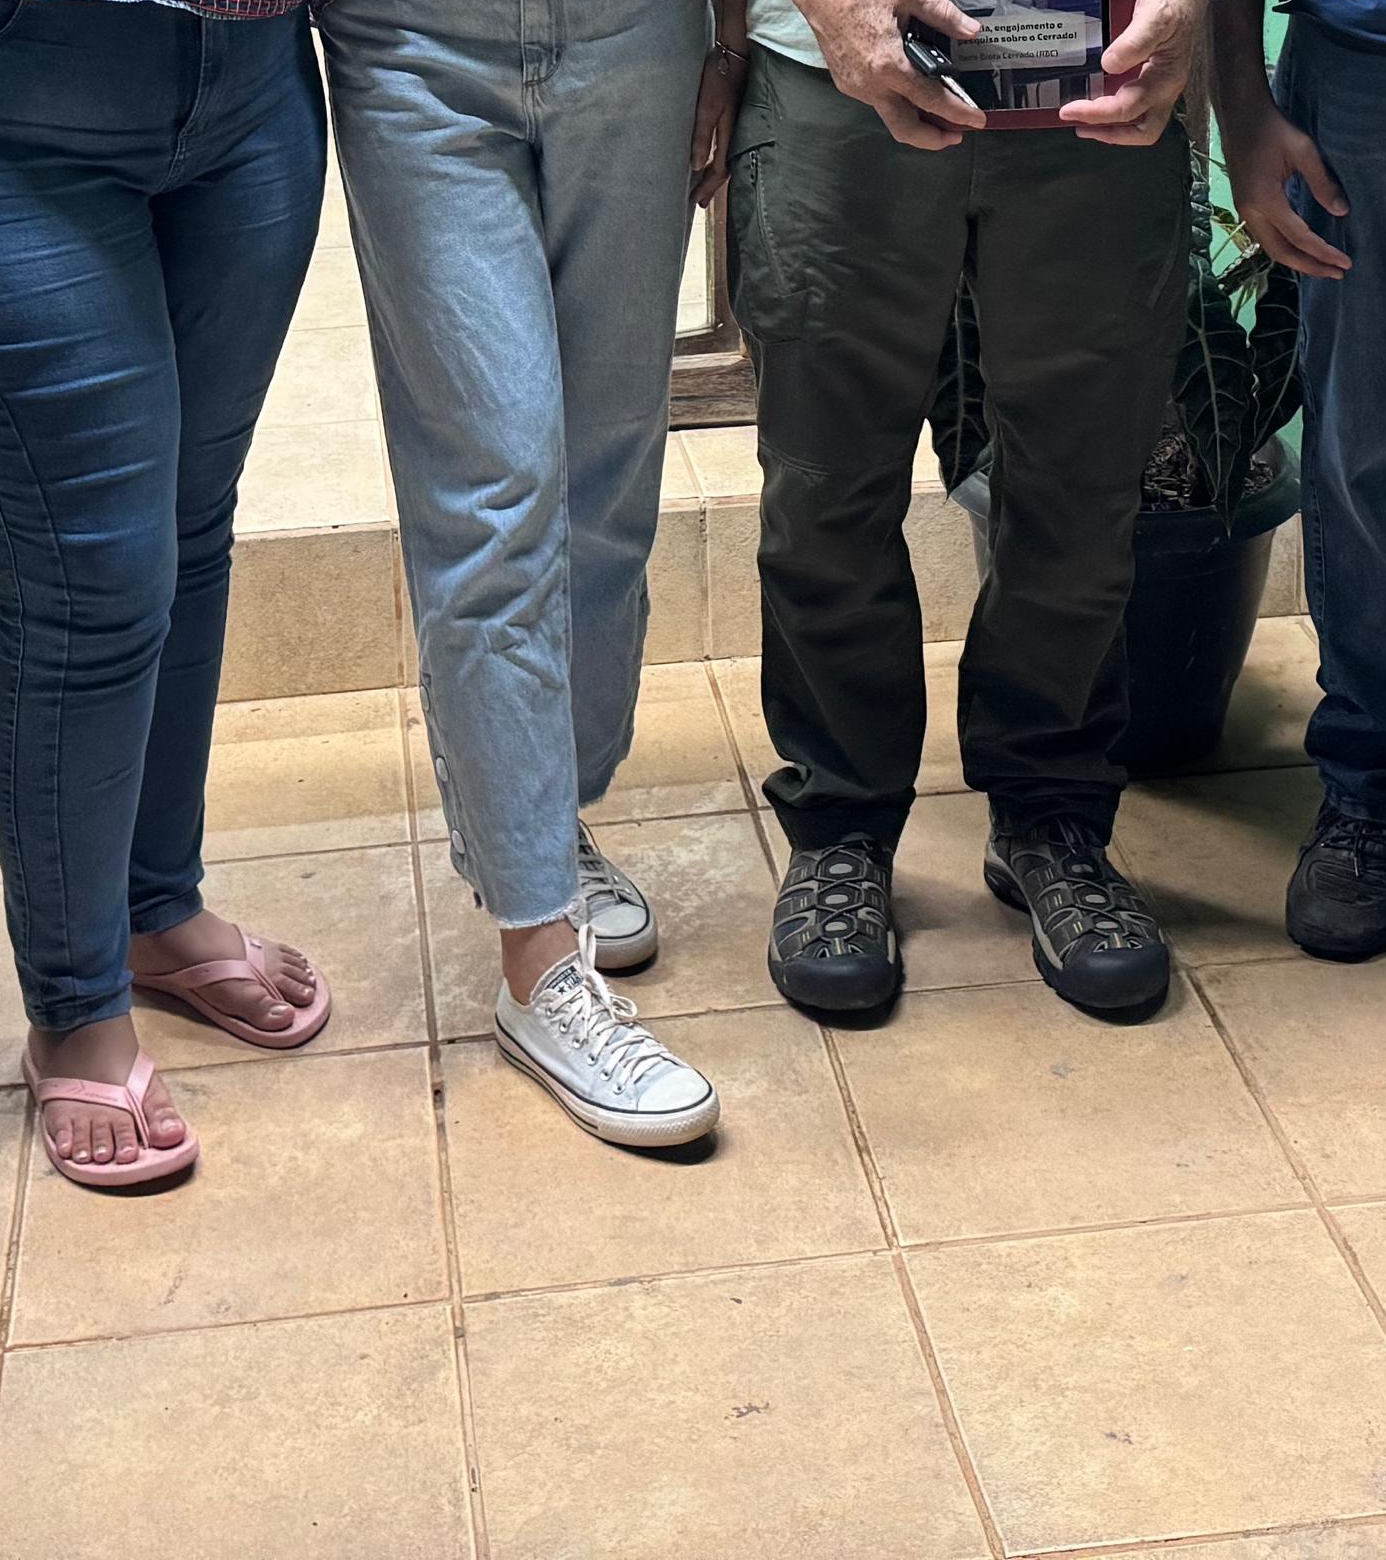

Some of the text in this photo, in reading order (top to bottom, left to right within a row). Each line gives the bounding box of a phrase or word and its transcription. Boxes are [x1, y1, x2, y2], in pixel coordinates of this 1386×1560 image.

[994, 22, 1055, 32] engajamento
[1000, 33, 1028, 43] sobre
[1037, 31, 1078, 41] Cerrado!
